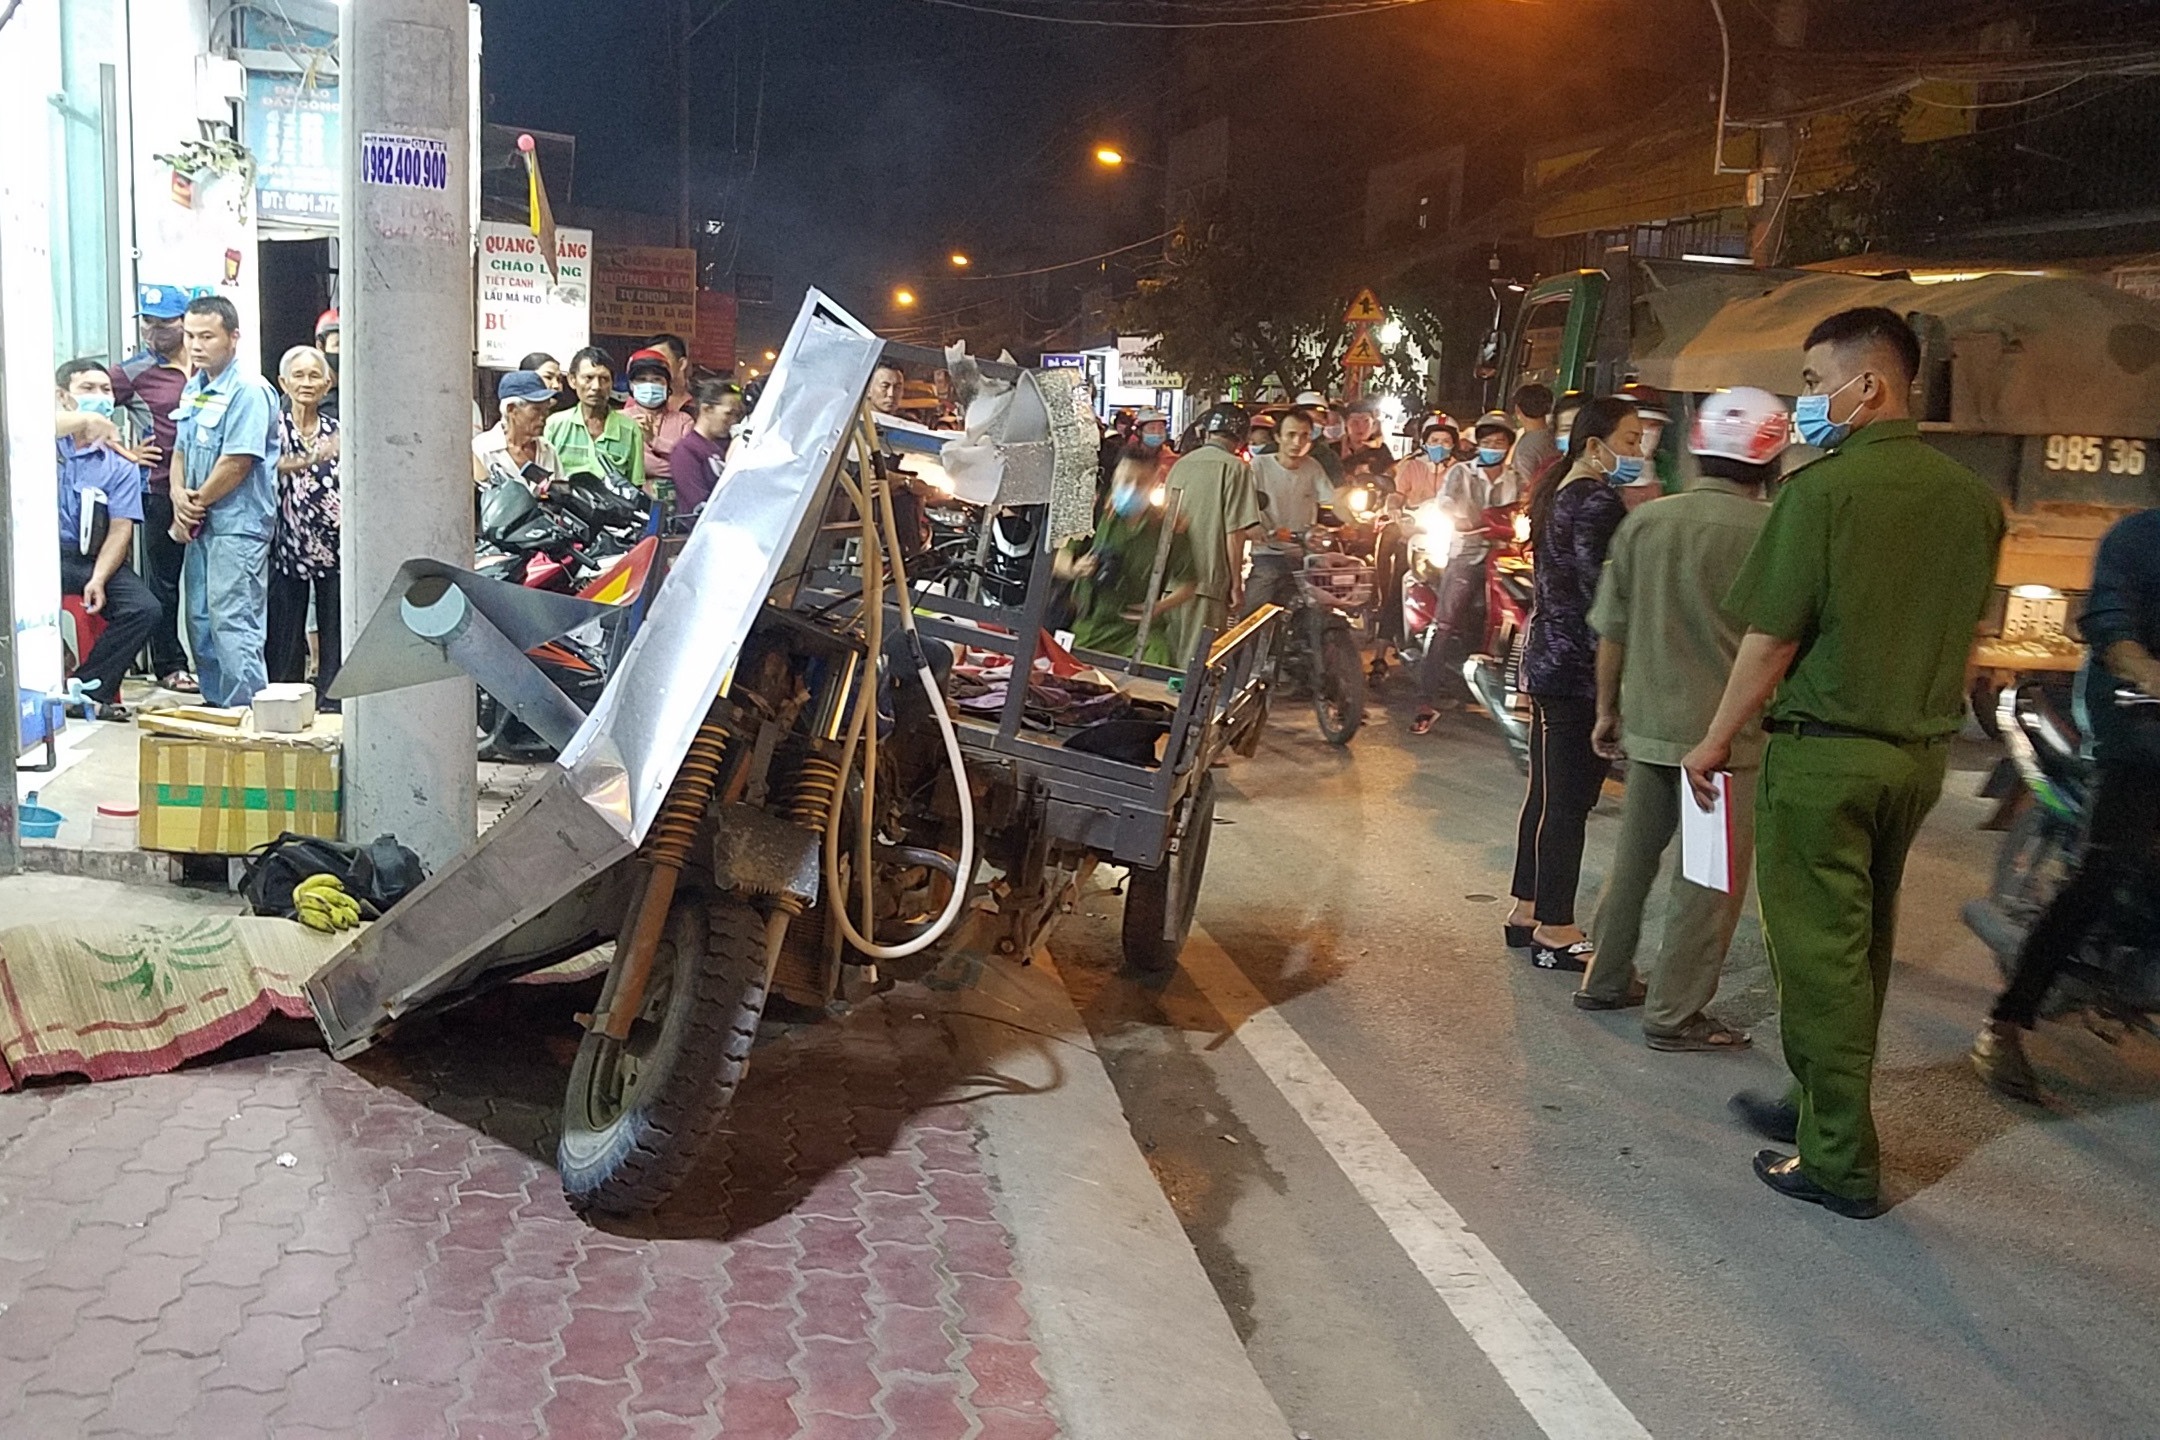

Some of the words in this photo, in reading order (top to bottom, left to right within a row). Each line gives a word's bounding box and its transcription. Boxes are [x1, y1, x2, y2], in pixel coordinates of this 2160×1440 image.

[485, 235, 536, 254] QUANG
[490, 259, 534, 273] CHÁO
[540, 263, 582, 278] LNG
[508, 277, 534, 289] CANH
